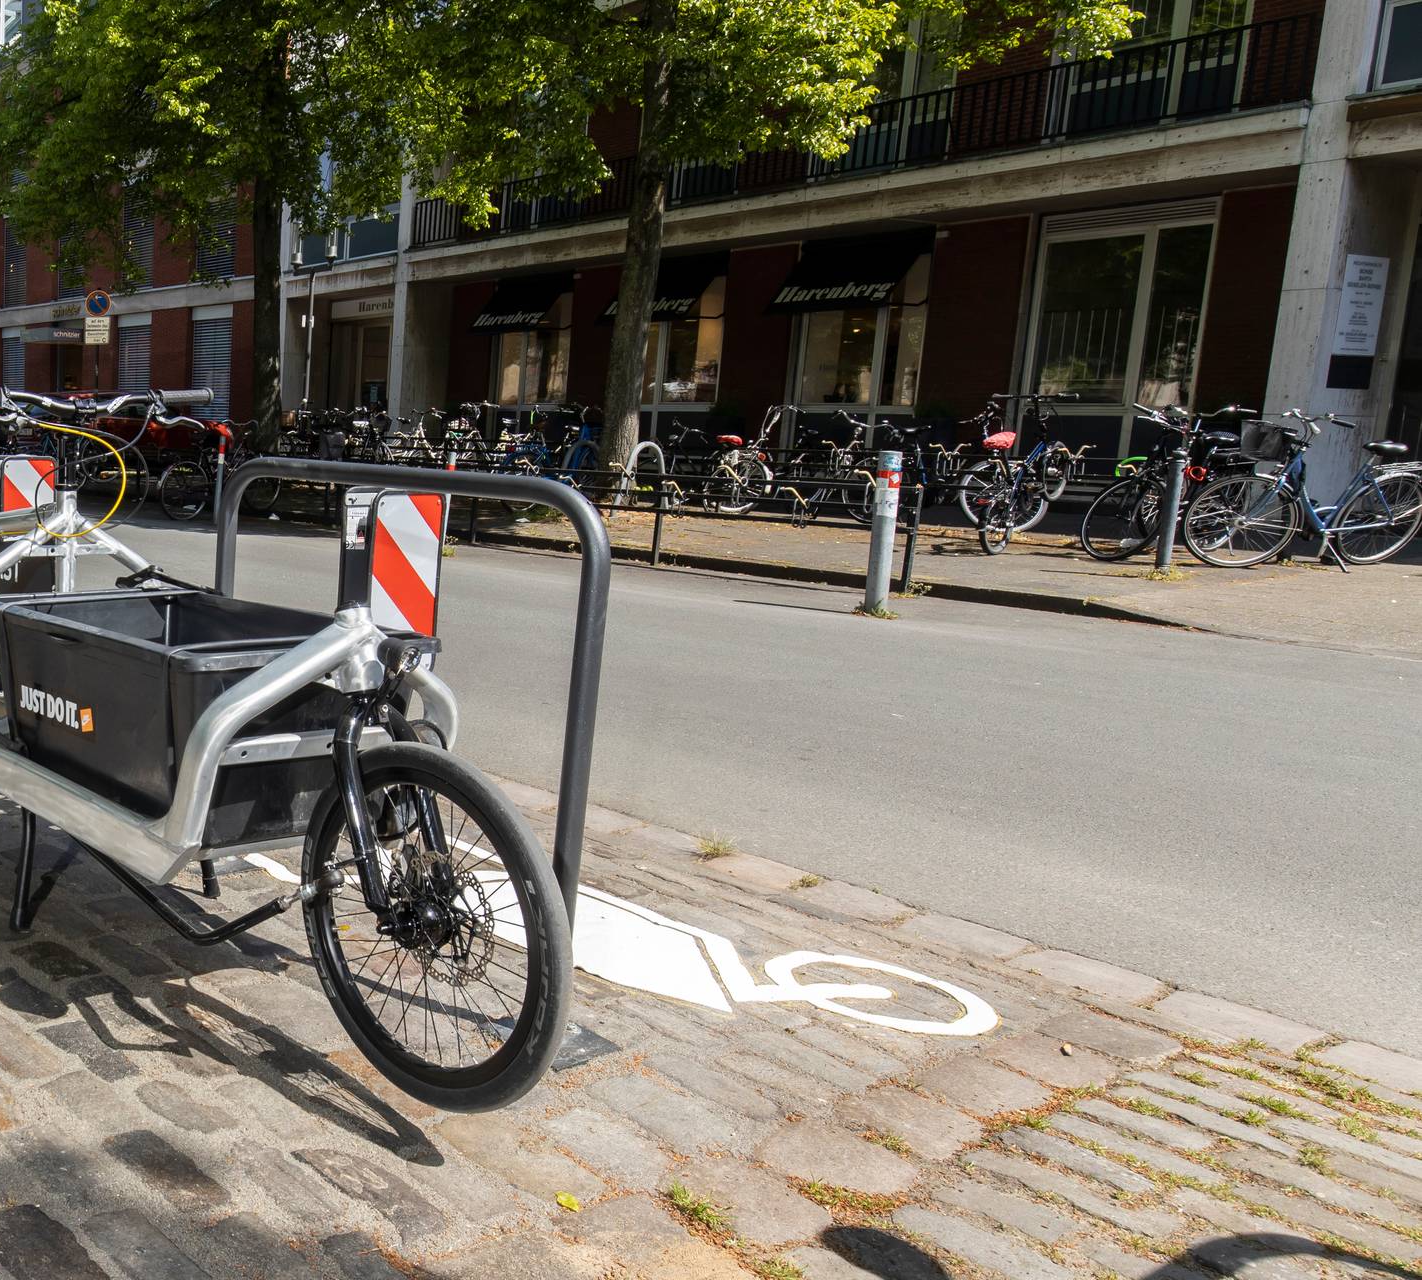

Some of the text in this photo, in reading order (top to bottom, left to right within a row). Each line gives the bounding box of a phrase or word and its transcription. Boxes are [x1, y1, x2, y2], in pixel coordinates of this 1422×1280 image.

[773, 281, 896, 303] Harenberg
[473, 310, 546, 327] Harenberg
[20, 684, 80, 730] JUST DO IT.
[525, 906, 550, 1056] KOJAK
